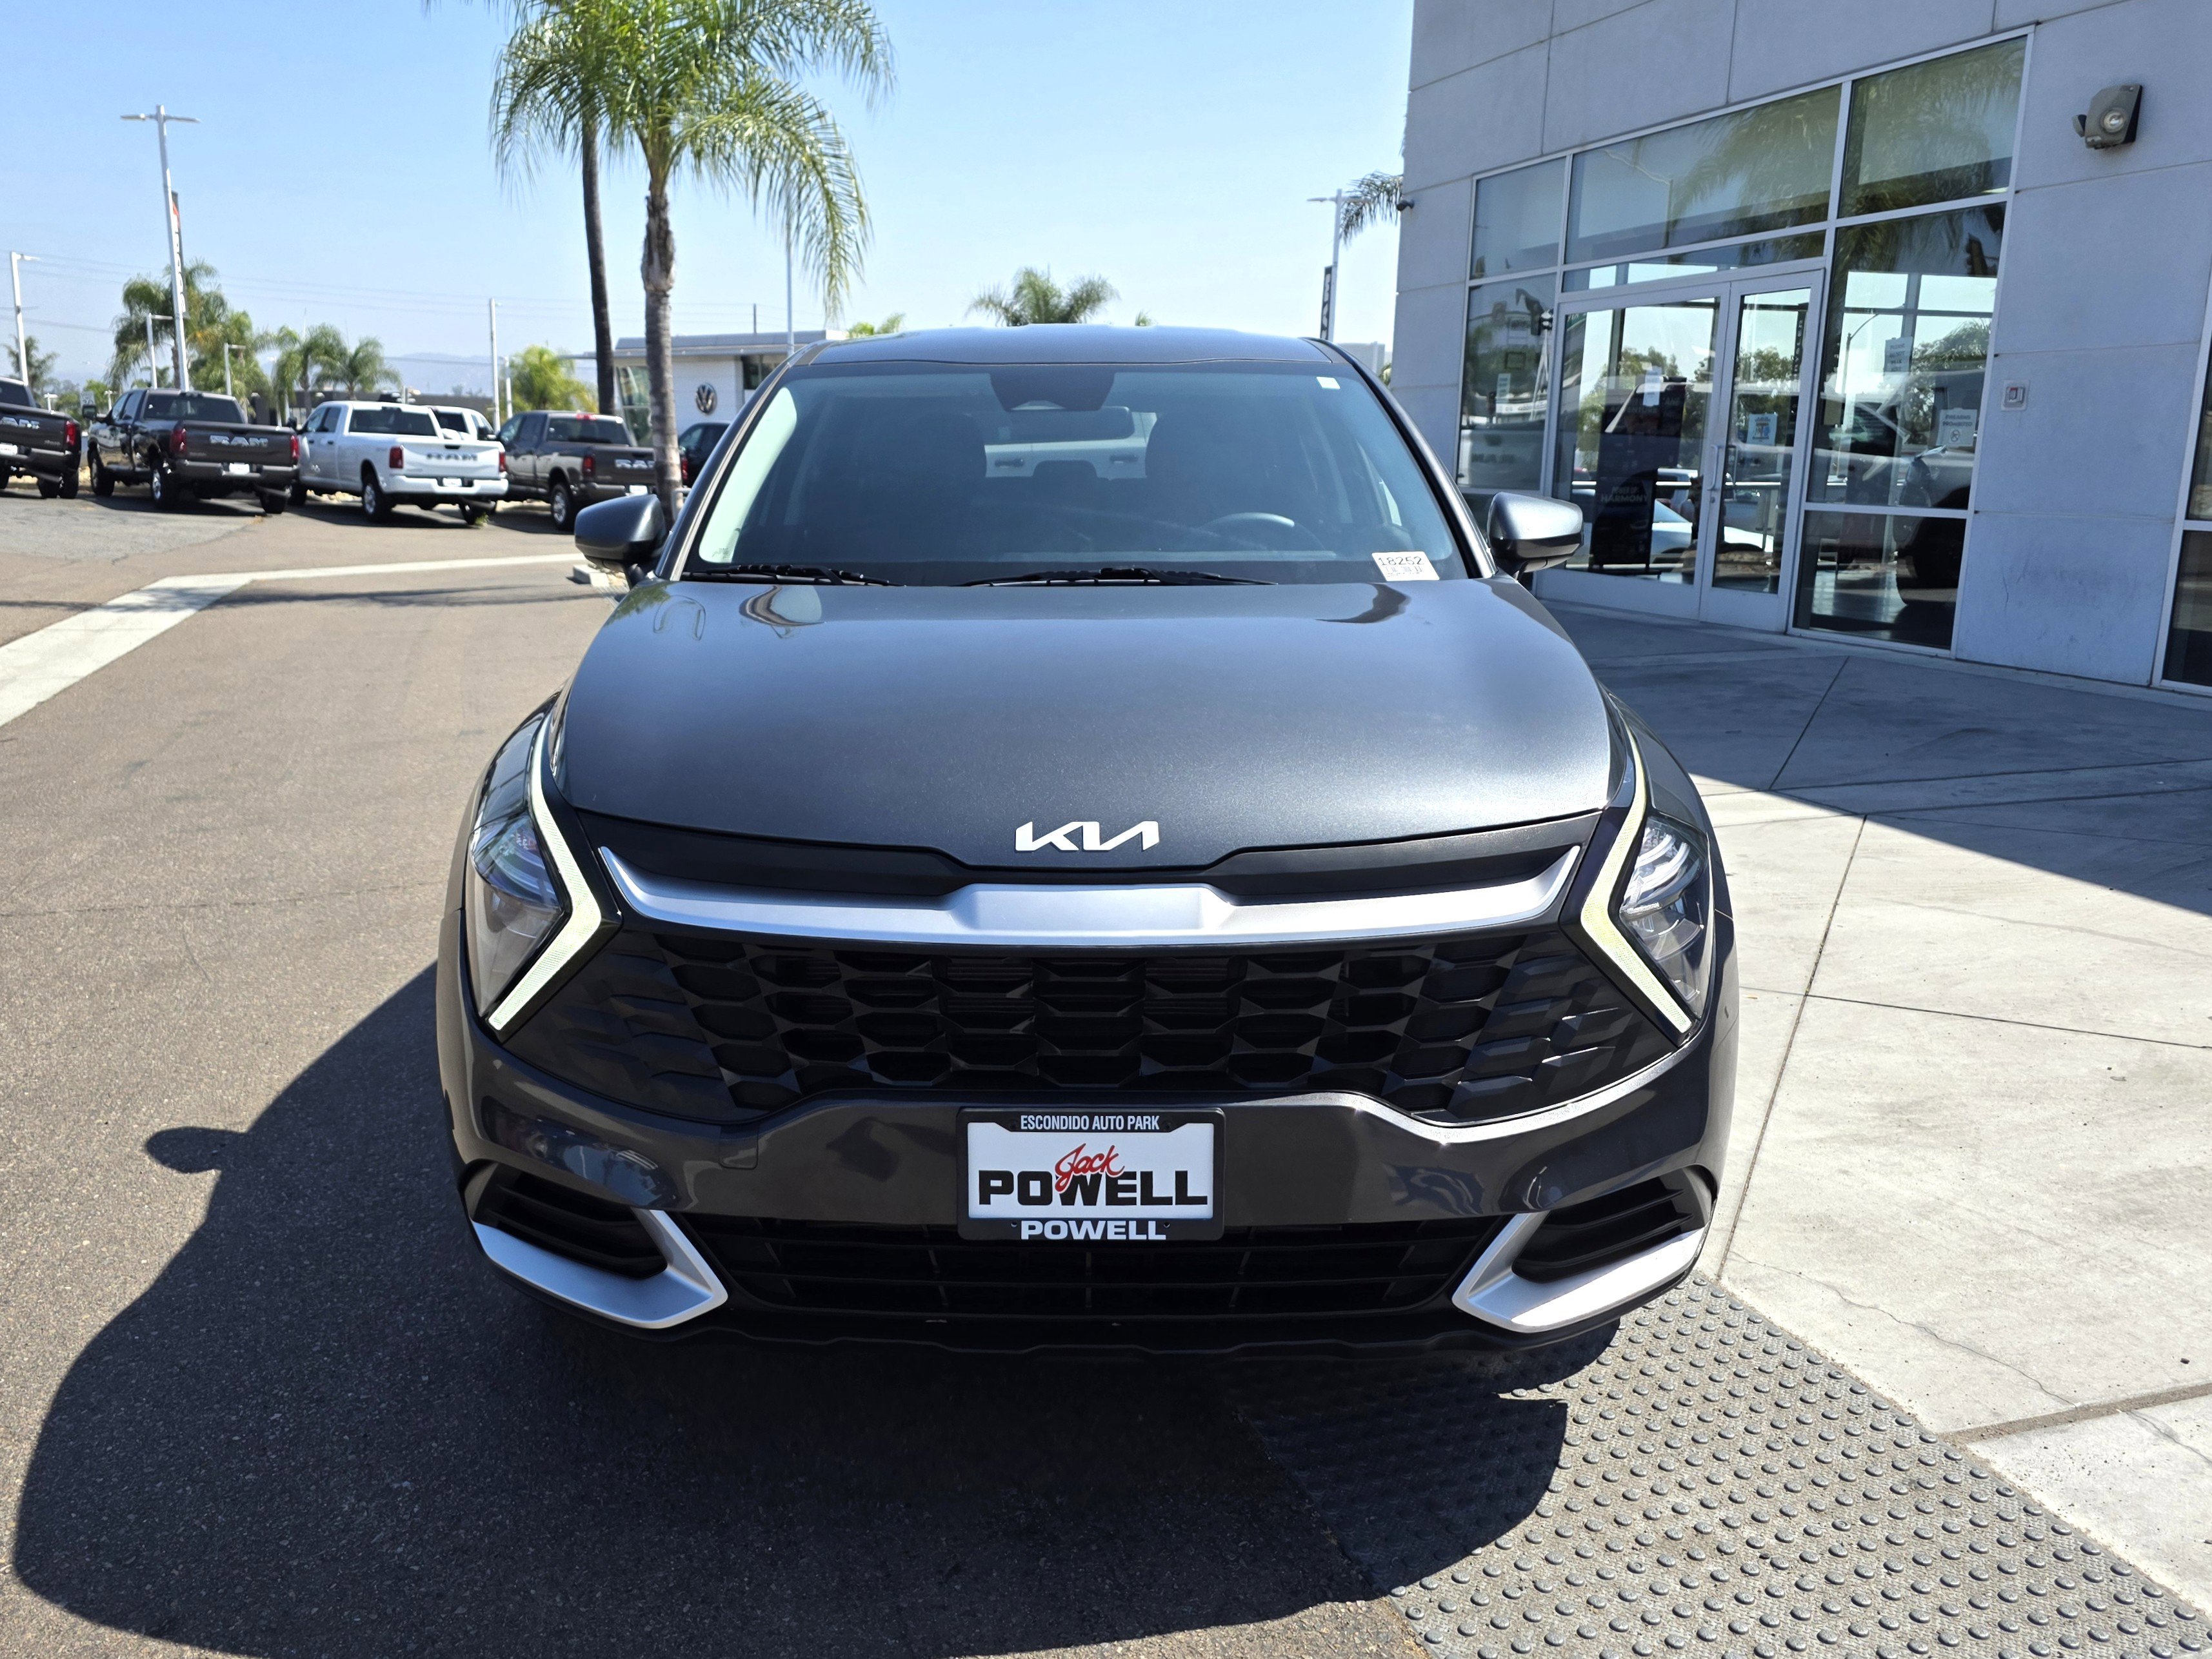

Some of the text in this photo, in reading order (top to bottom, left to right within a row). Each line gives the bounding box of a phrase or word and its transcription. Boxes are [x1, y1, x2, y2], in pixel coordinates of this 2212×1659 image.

[0, 416, 39, 430] AM
[210, 435, 268, 447] RAM
[426, 452, 477, 461] RAM
[1378, 556, 1424, 566] 18252
[1015, 820, 1160, 851] KIA
[1020, 1115, 1160, 1130] ESCONDIDO AUTO PARK
[1055, 1142, 1126, 1193] Jack
[978, 1169, 1208, 1206] POWELL
[1021, 1220, 1167, 1240] POWELL
